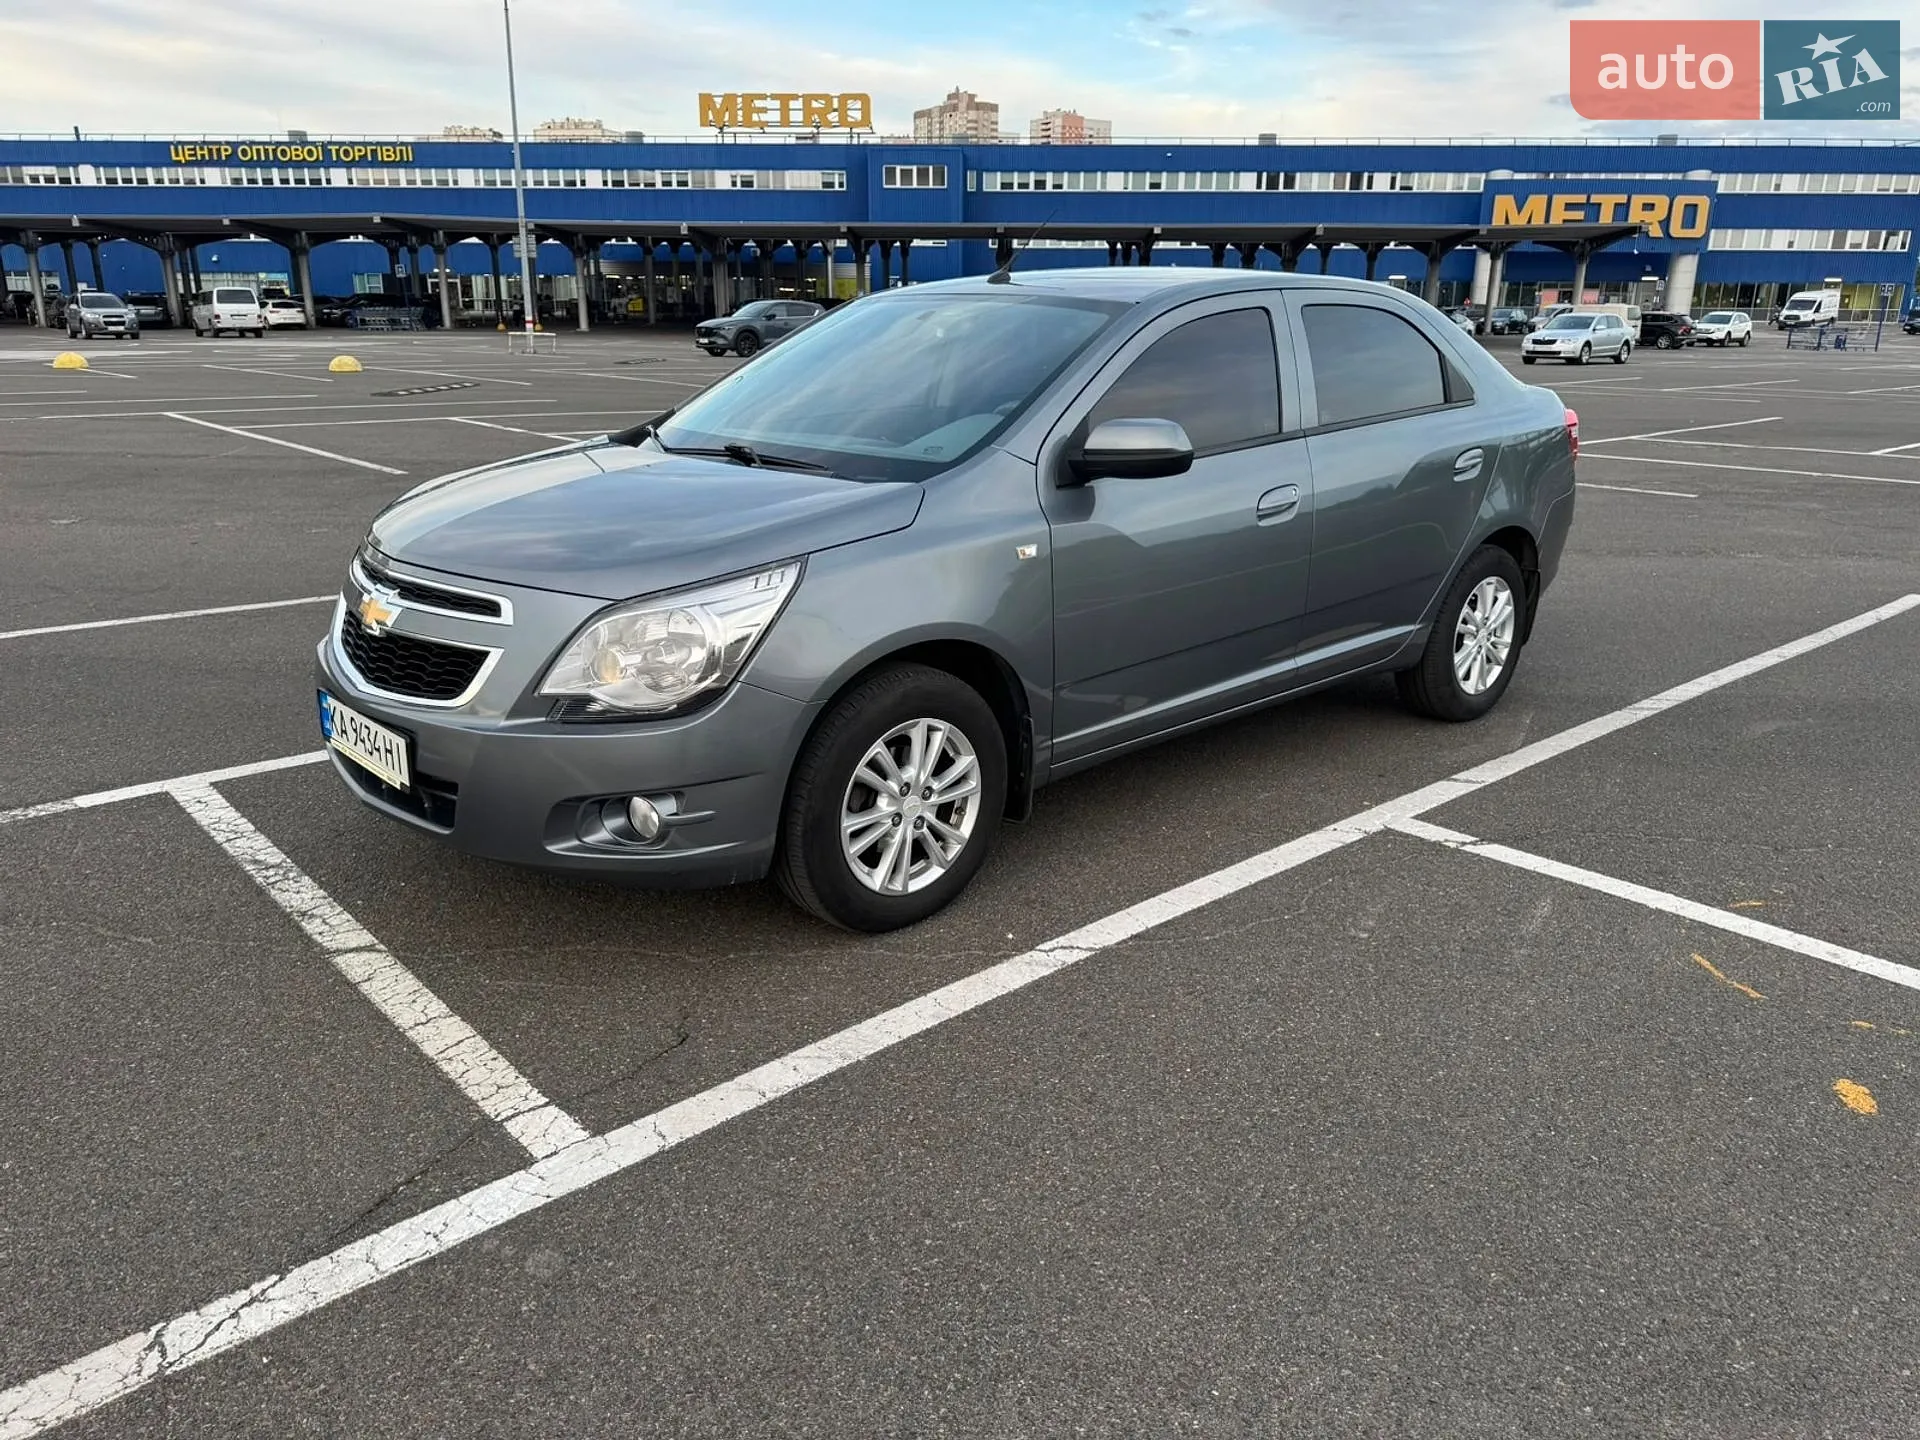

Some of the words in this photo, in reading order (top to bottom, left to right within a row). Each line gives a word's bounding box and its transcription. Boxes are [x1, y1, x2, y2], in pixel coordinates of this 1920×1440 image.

[698, 93, 872, 128] METRO
[170, 144, 232, 164] ЦЕНТР
[237, 142, 324, 162] ОПТОВОЇ
[328, 145, 413, 162] ТОРГІВЛІ
[1491, 194, 1711, 239] METRO
[350, 716, 382, 762] 9434
